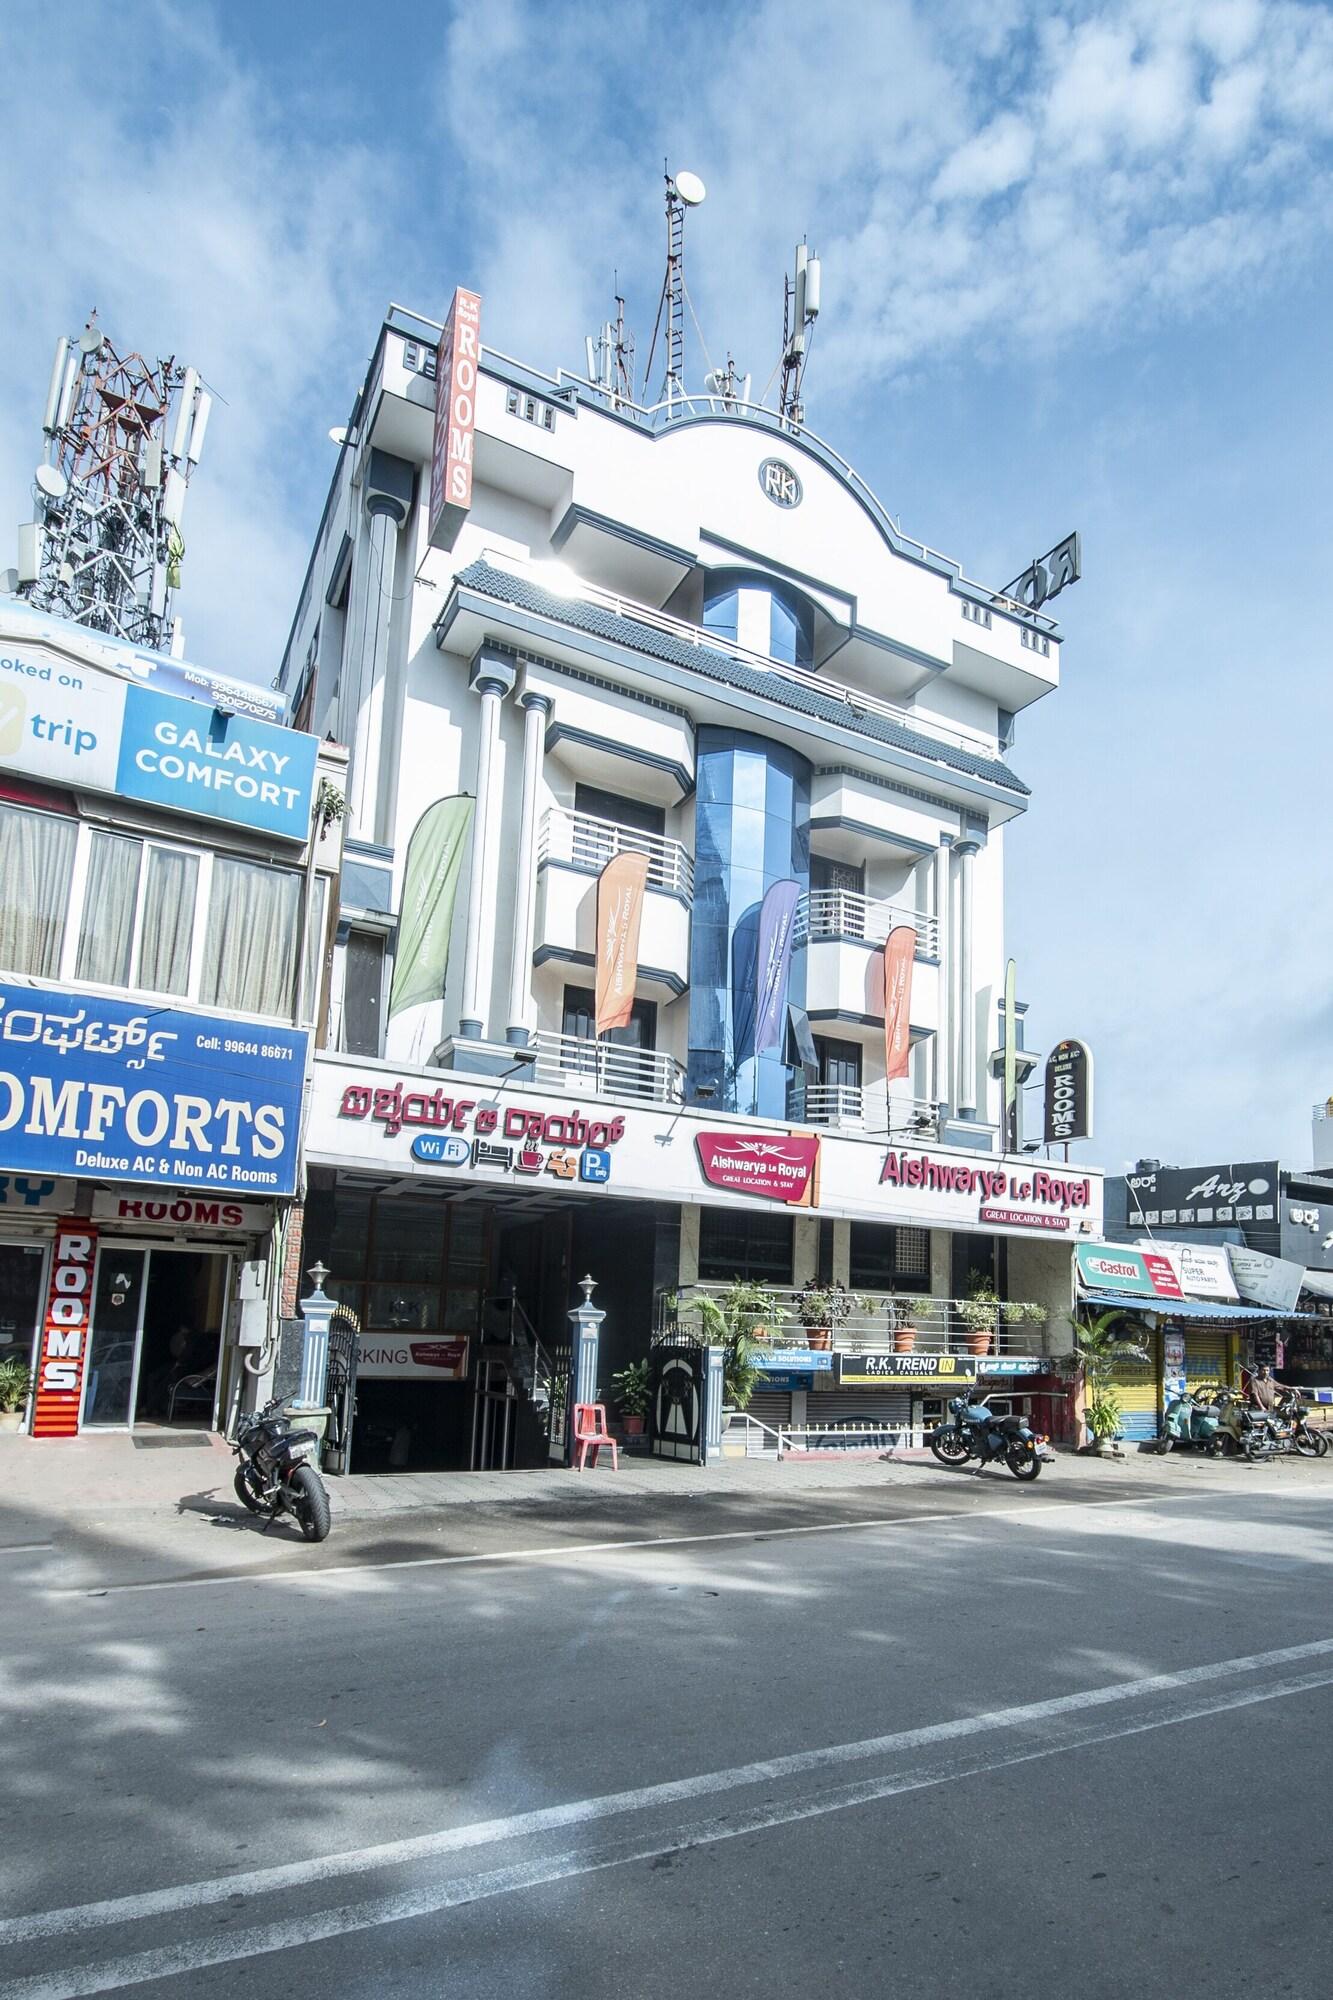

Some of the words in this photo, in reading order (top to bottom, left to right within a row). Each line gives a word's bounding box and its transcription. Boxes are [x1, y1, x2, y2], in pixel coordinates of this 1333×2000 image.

[451, 323, 476, 500] ROOMS
[58, 671, 83, 691] on
[30, 713, 98, 756] trip
[154, 721, 290, 776] GALAXY
[135, 749, 301, 811] COMFORT
[196, 1034, 221, 1051] Cell:
[224, 1039, 258, 1057] 99644
[261, 1044, 293, 1061] 86671
[1051, 1074, 1076, 1137] ROOMS
[75, 1151, 129, 1171] Deluxe
[132, 1156, 155, 1173] AC
[159, 1157, 171, 1174] &
[174, 1160, 203, 1178] Non
[206, 1164, 229, 1180] AC
[231, 1165, 278, 1184] Rooms
[710, 1154, 767, 1175] Aishwarya
[778, 1163, 807, 1179] Royal
[743, 1177, 772, 1186] LOCATION
[879, 1152, 1008, 1201] Aishwarya
[1010, 1176, 1031, 1200] Le
[1032, 1171, 1092, 1210] Royal
[117, 1199, 244, 1226] ROOMS
[985, 1210, 1007, 1220] GREAT
[1010, 1212, 1042, 1224] LOCATION
[1044, 1216, 1050, 1225] &
[1052, 1218, 1068, 1227] STAY
[1100, 1260, 1138, 1278] Castrol
[42, 1236, 91, 1391] ROOMS
[866, 1357, 892, 1371] R.K.
[895, 1357, 938, 1371] TREND
